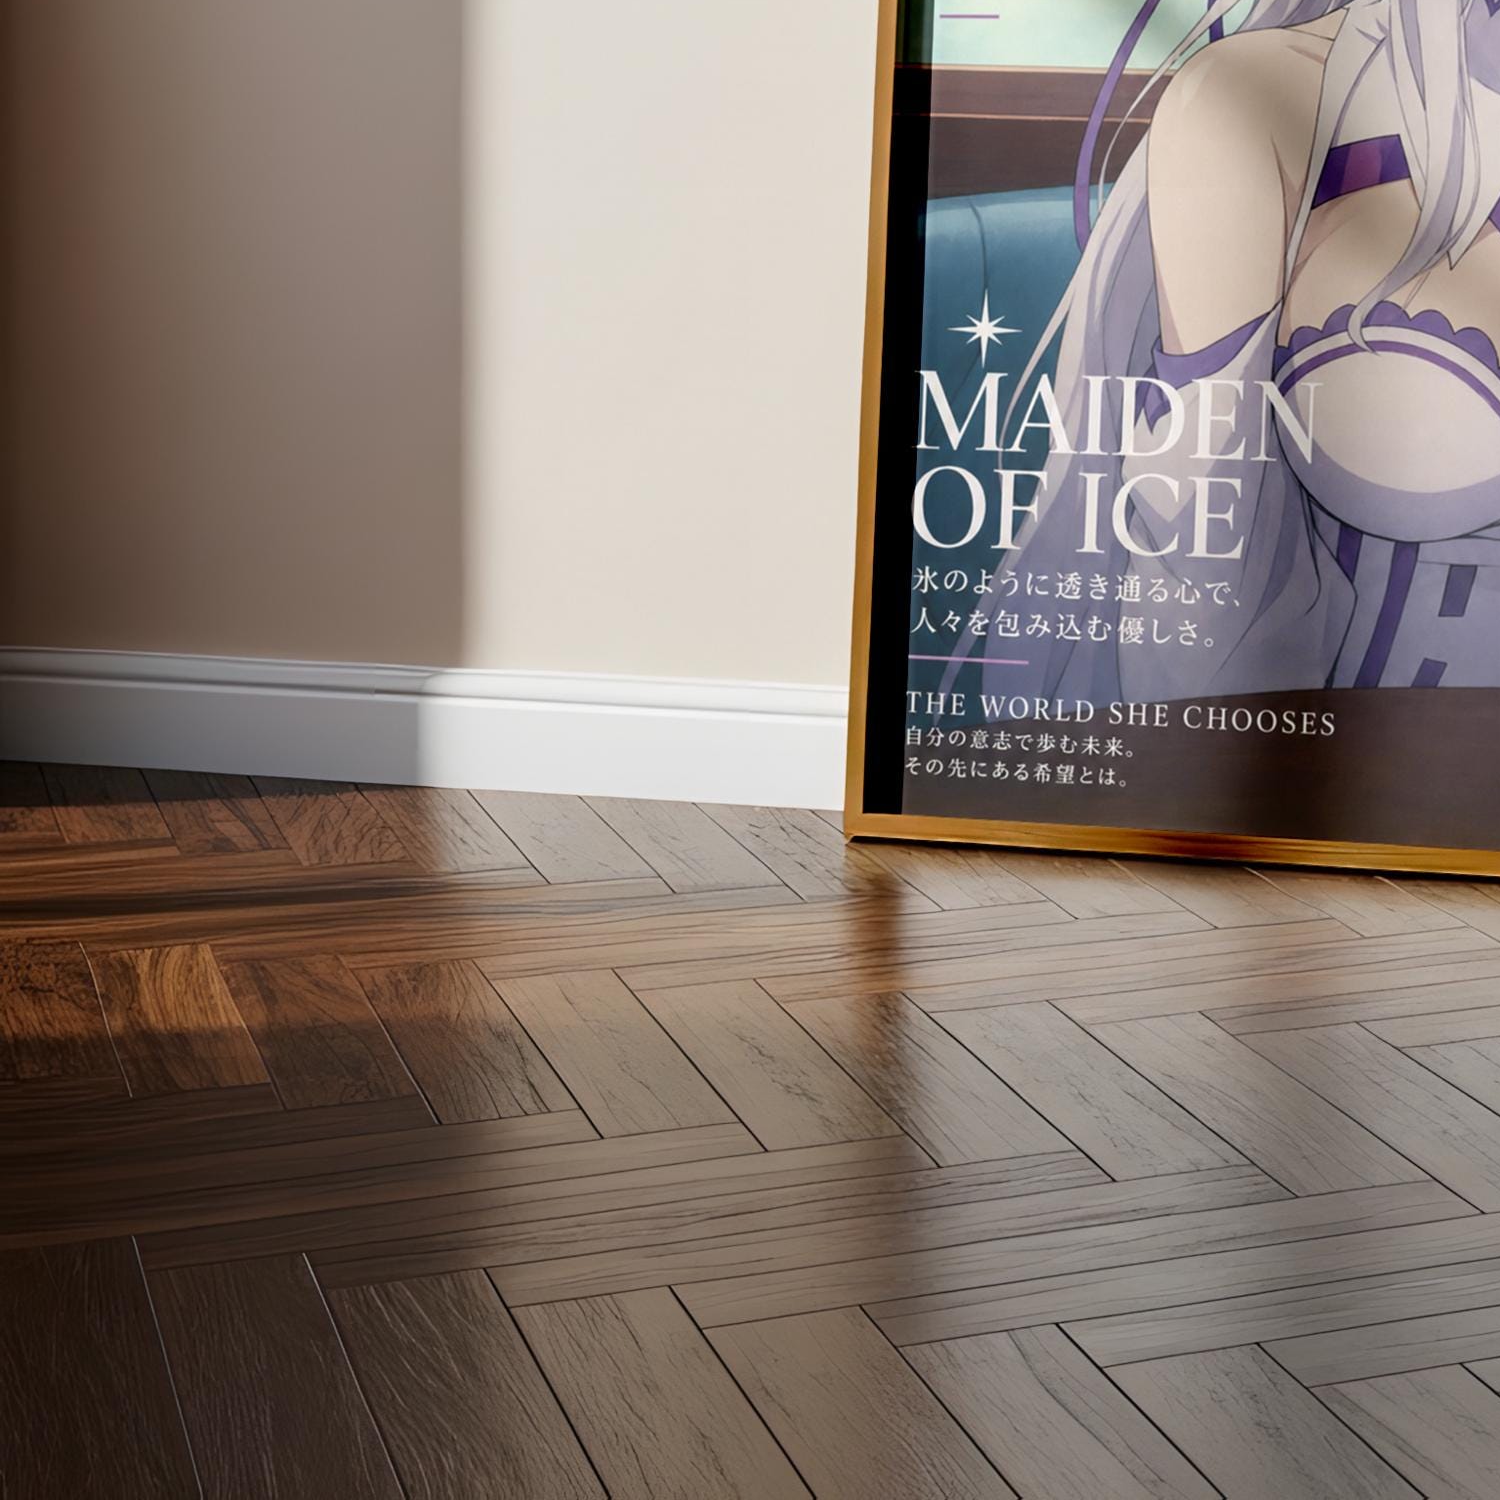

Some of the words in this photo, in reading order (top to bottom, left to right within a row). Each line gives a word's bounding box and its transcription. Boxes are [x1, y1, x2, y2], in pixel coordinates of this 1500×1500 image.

[912, 368, 1324, 465] MAIDEN
[911, 464, 1049, 552] OF
[1075, 472, 1245, 560] ICE
[912, 565, 1242, 607] 氷のように透き通る心で、
[909, 608, 1215, 648] 人々を包み込む優しさ。
[905, 690, 967, 716] THE
[979, 694, 1095, 723] WORLD
[1108, 701, 1170, 728] SHE
[1182, 705, 1337, 737] CHOOSES
[905, 725, 1135, 759] 自分の意志で歩む未来。
[904, 755, 1129, 788] その先にある希望とは。
